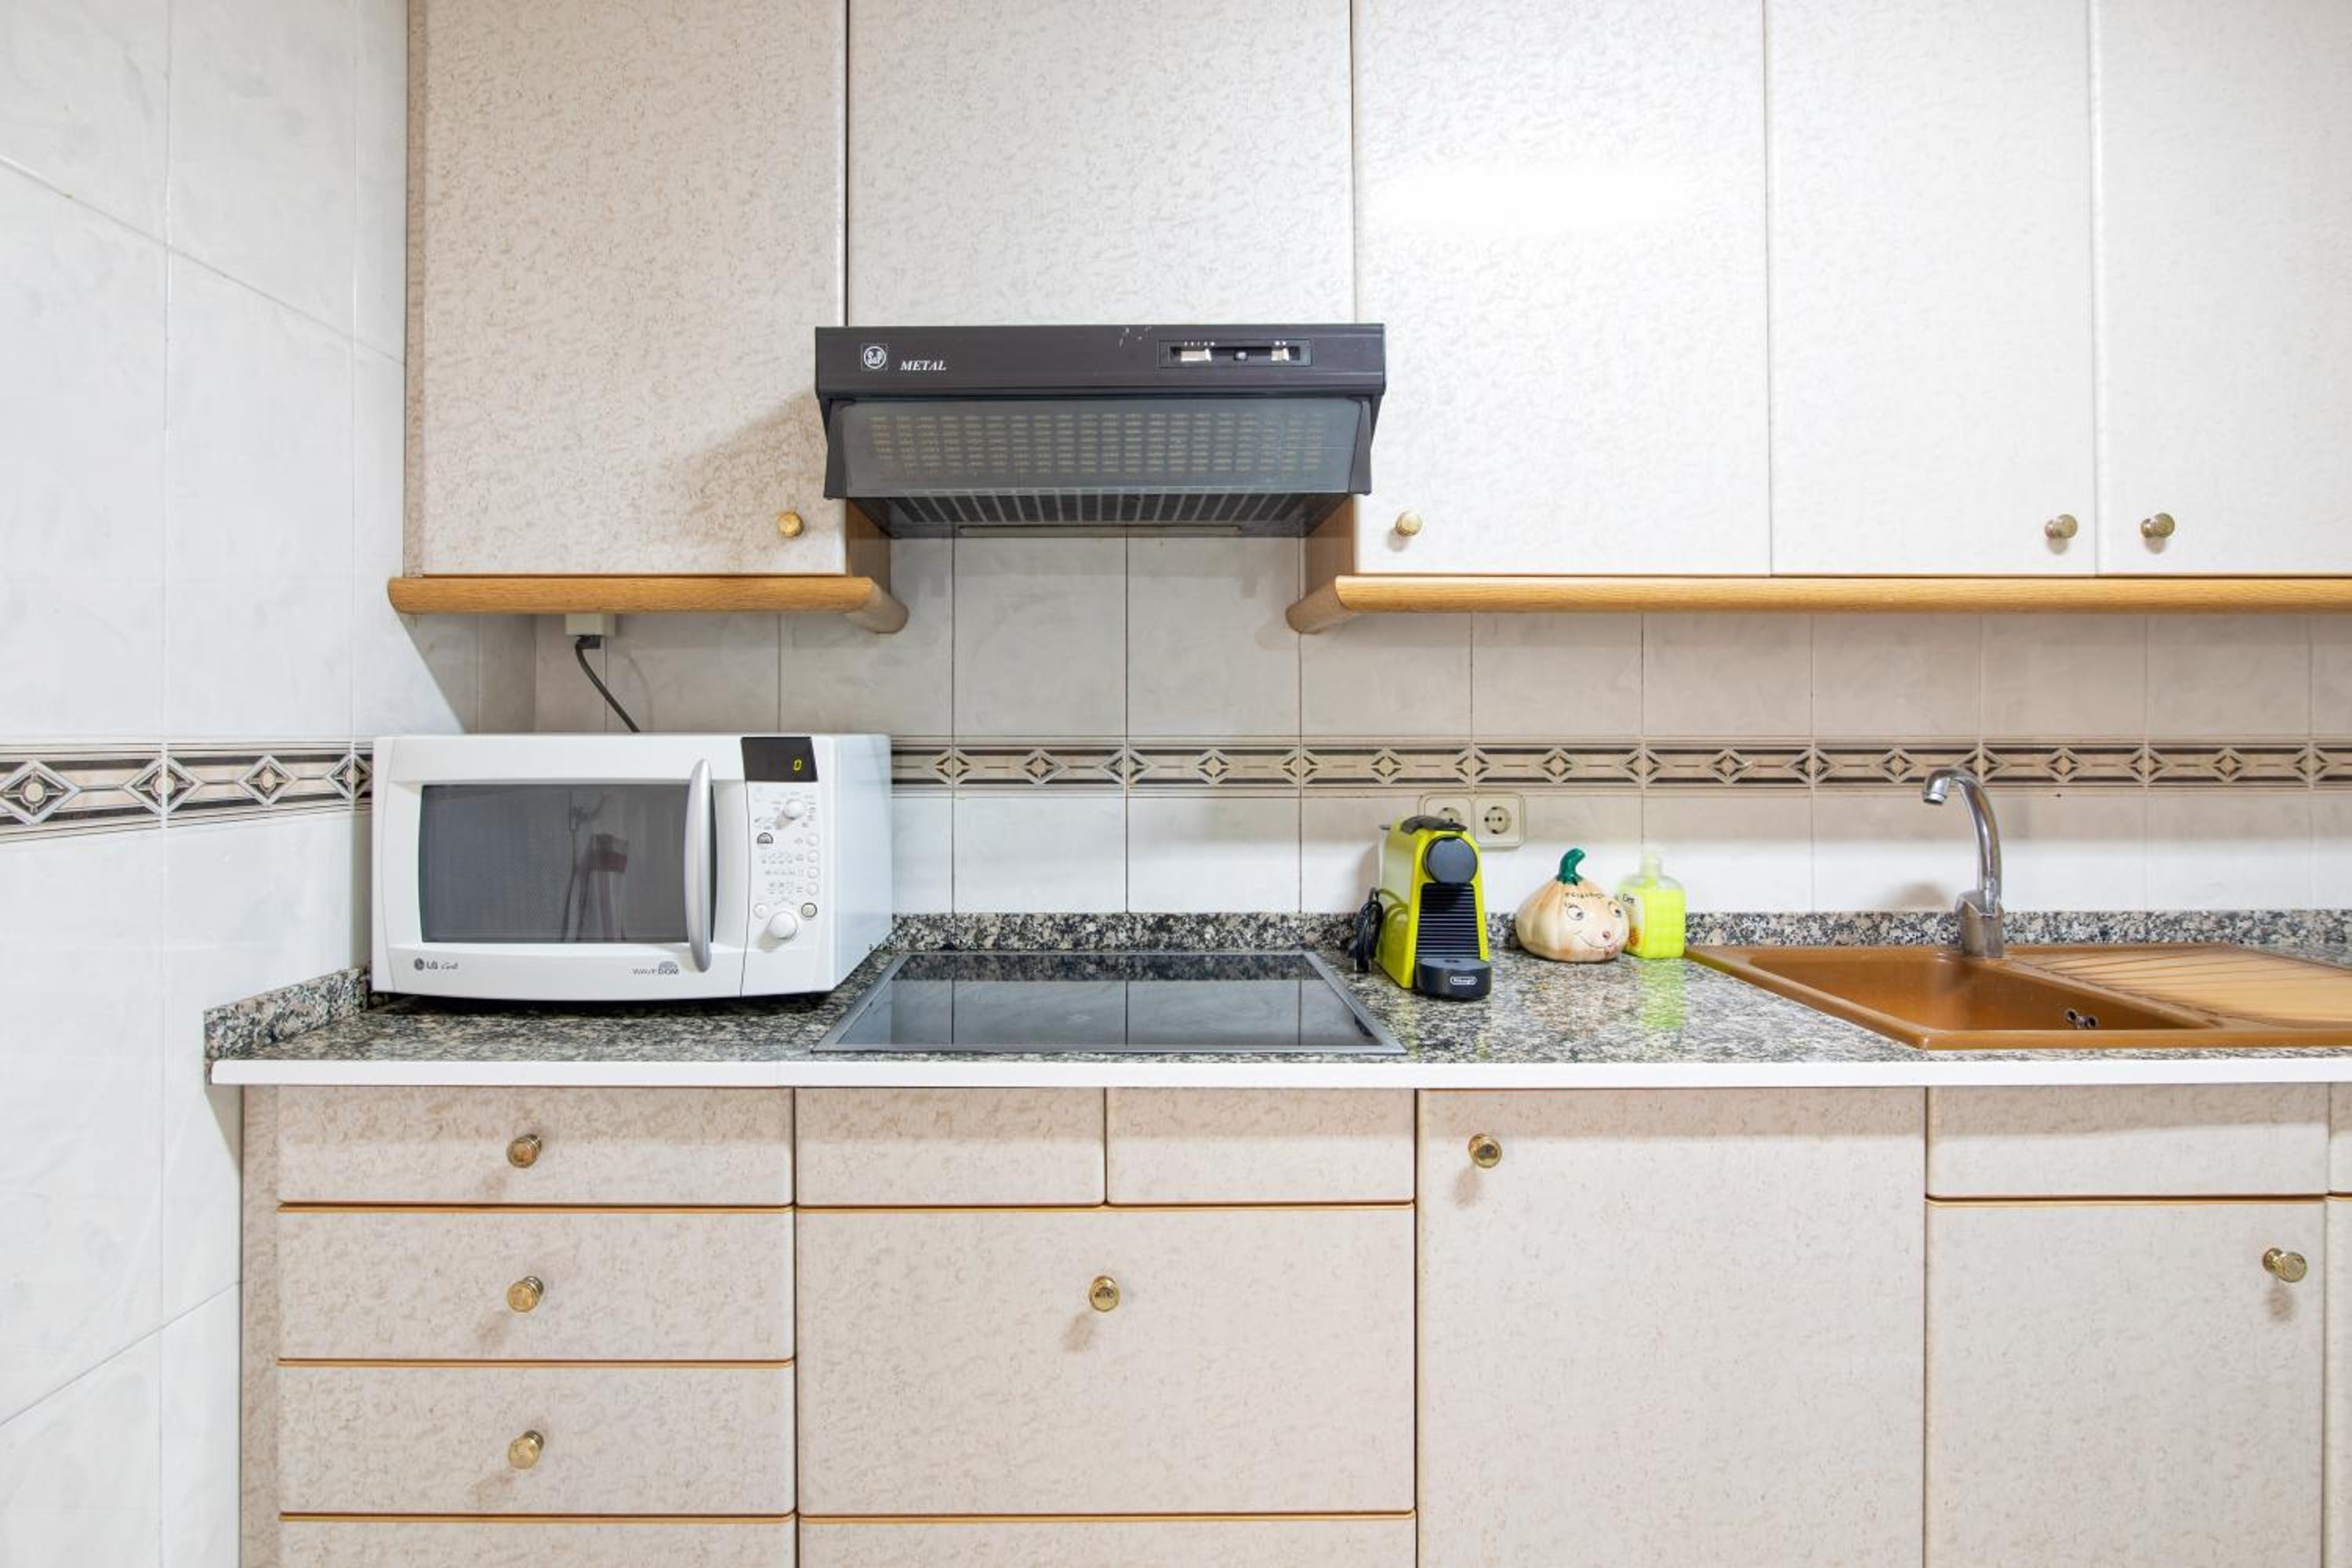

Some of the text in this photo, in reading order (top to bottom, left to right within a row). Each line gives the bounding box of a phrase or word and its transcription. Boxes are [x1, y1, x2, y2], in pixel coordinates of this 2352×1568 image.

[899, 360, 946, 371] METAL
[793, 759, 802, 771] 0
[426, 960, 438, 970] LG
